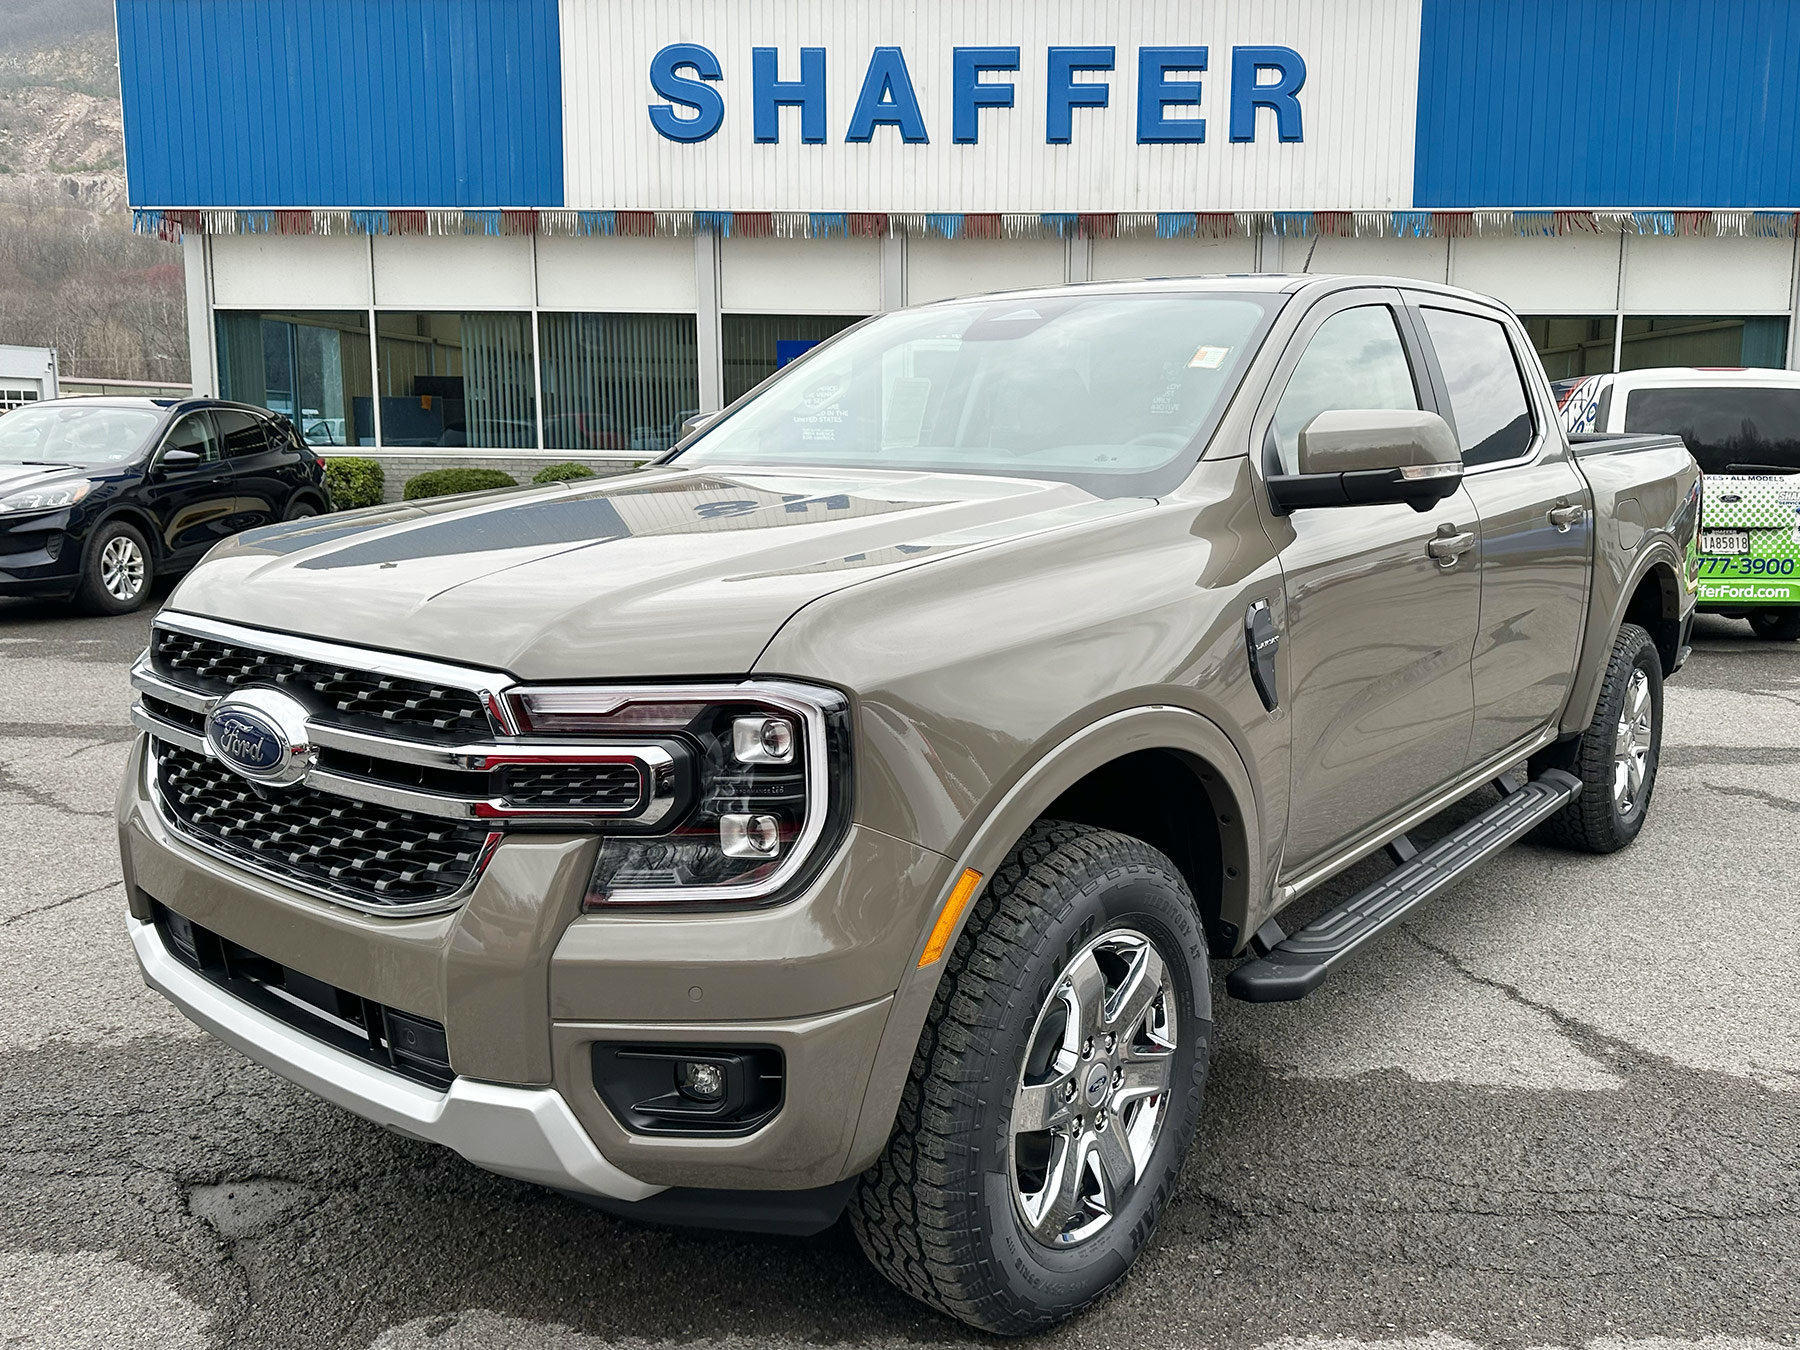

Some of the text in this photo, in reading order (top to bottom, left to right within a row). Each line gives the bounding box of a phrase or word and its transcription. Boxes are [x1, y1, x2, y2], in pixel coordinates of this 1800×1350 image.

[648, 42, 1307, 145] SHAFFER
[1704, 536, 1748, 549] 1A85818
[1698, 584, 1790, 598] ferFord.com
[220, 718, 265, 763] Ford
